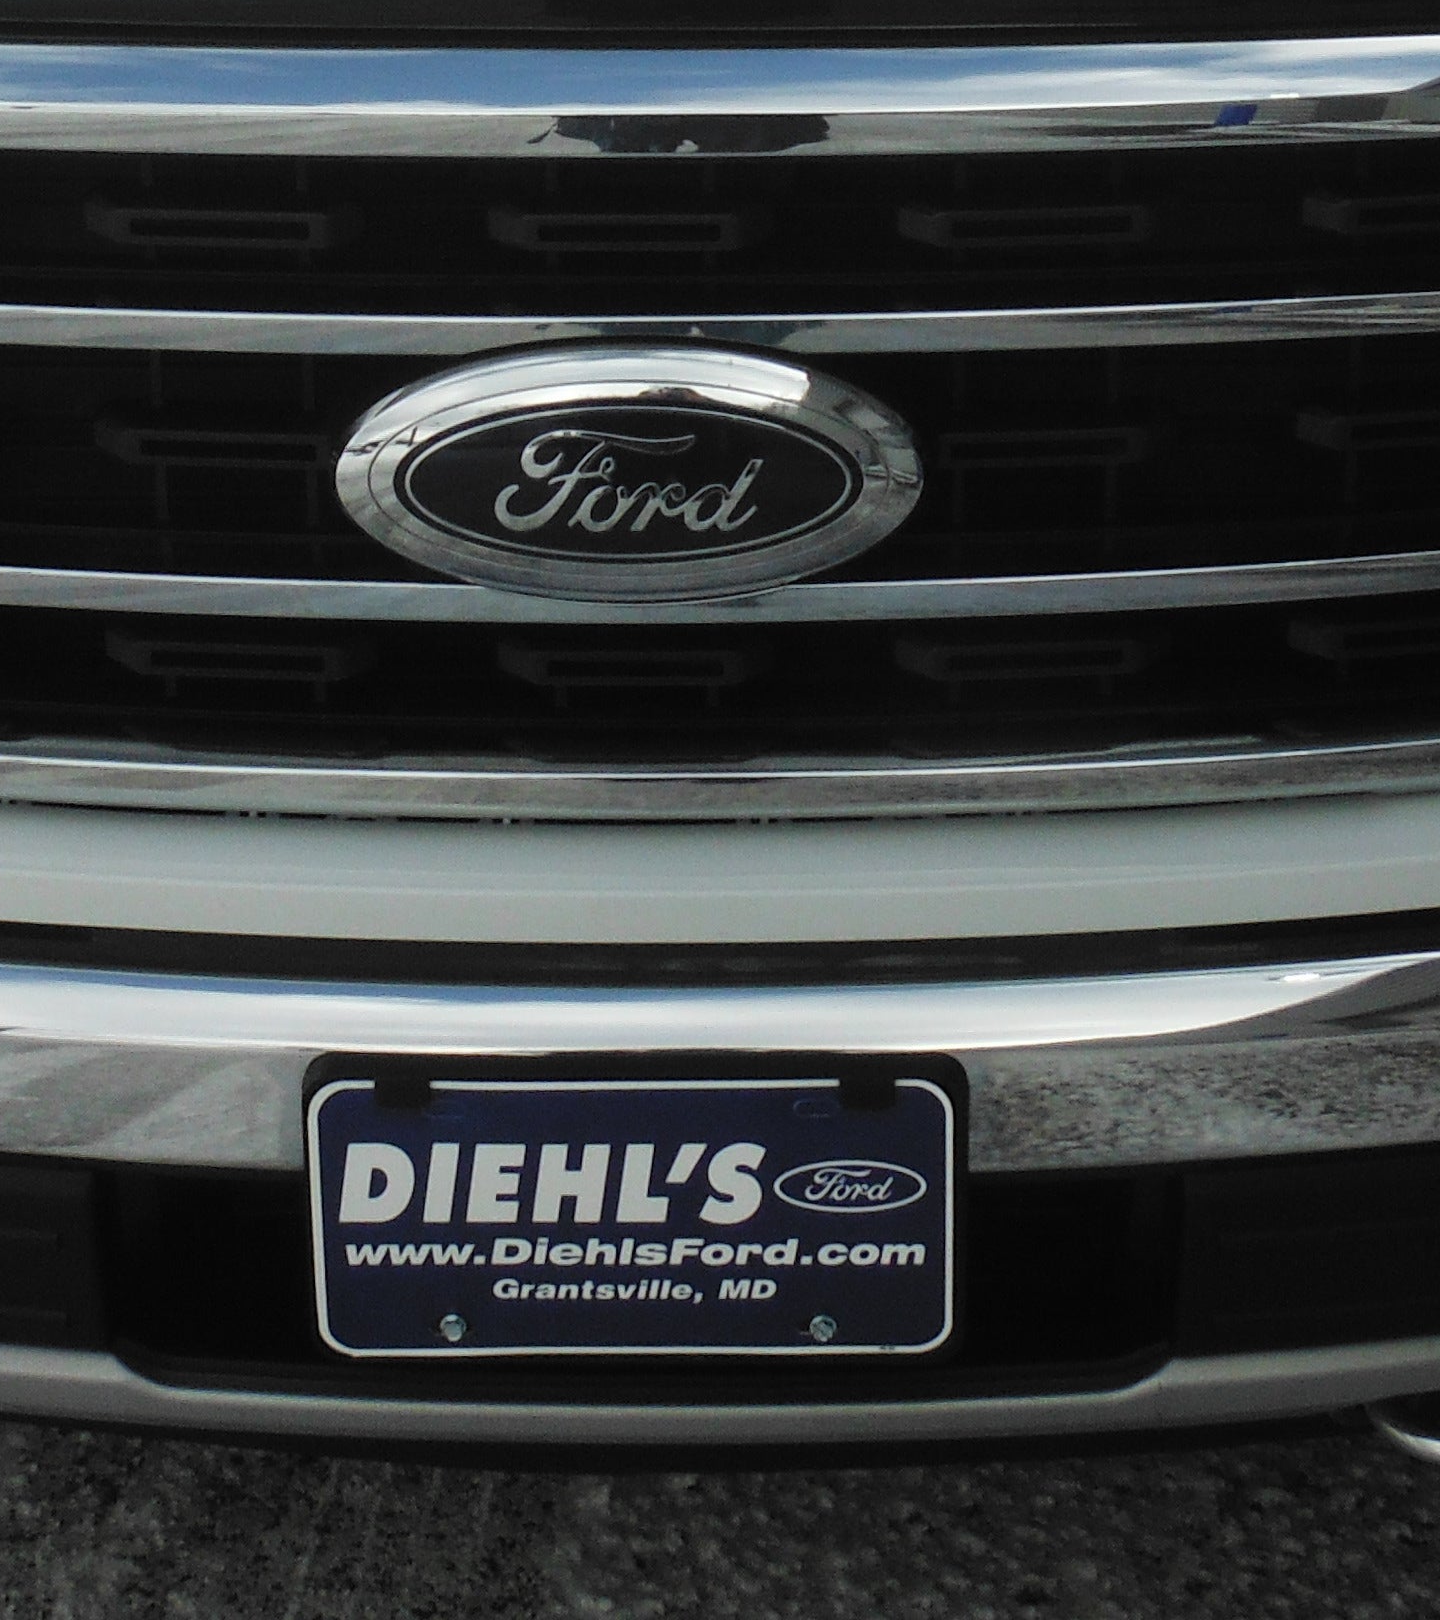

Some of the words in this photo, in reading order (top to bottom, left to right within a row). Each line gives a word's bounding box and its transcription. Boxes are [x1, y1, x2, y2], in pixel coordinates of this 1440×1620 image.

[494, 429, 764, 533] Ford
[339, 1142, 766, 1224] DIEHL'S
[804, 1168, 893, 1202] Ford
[345, 1237, 926, 1267] www.DiehlsFord.com
[492, 1278, 703, 1304] Grantsville,
[718, 1279, 777, 1300] MD
